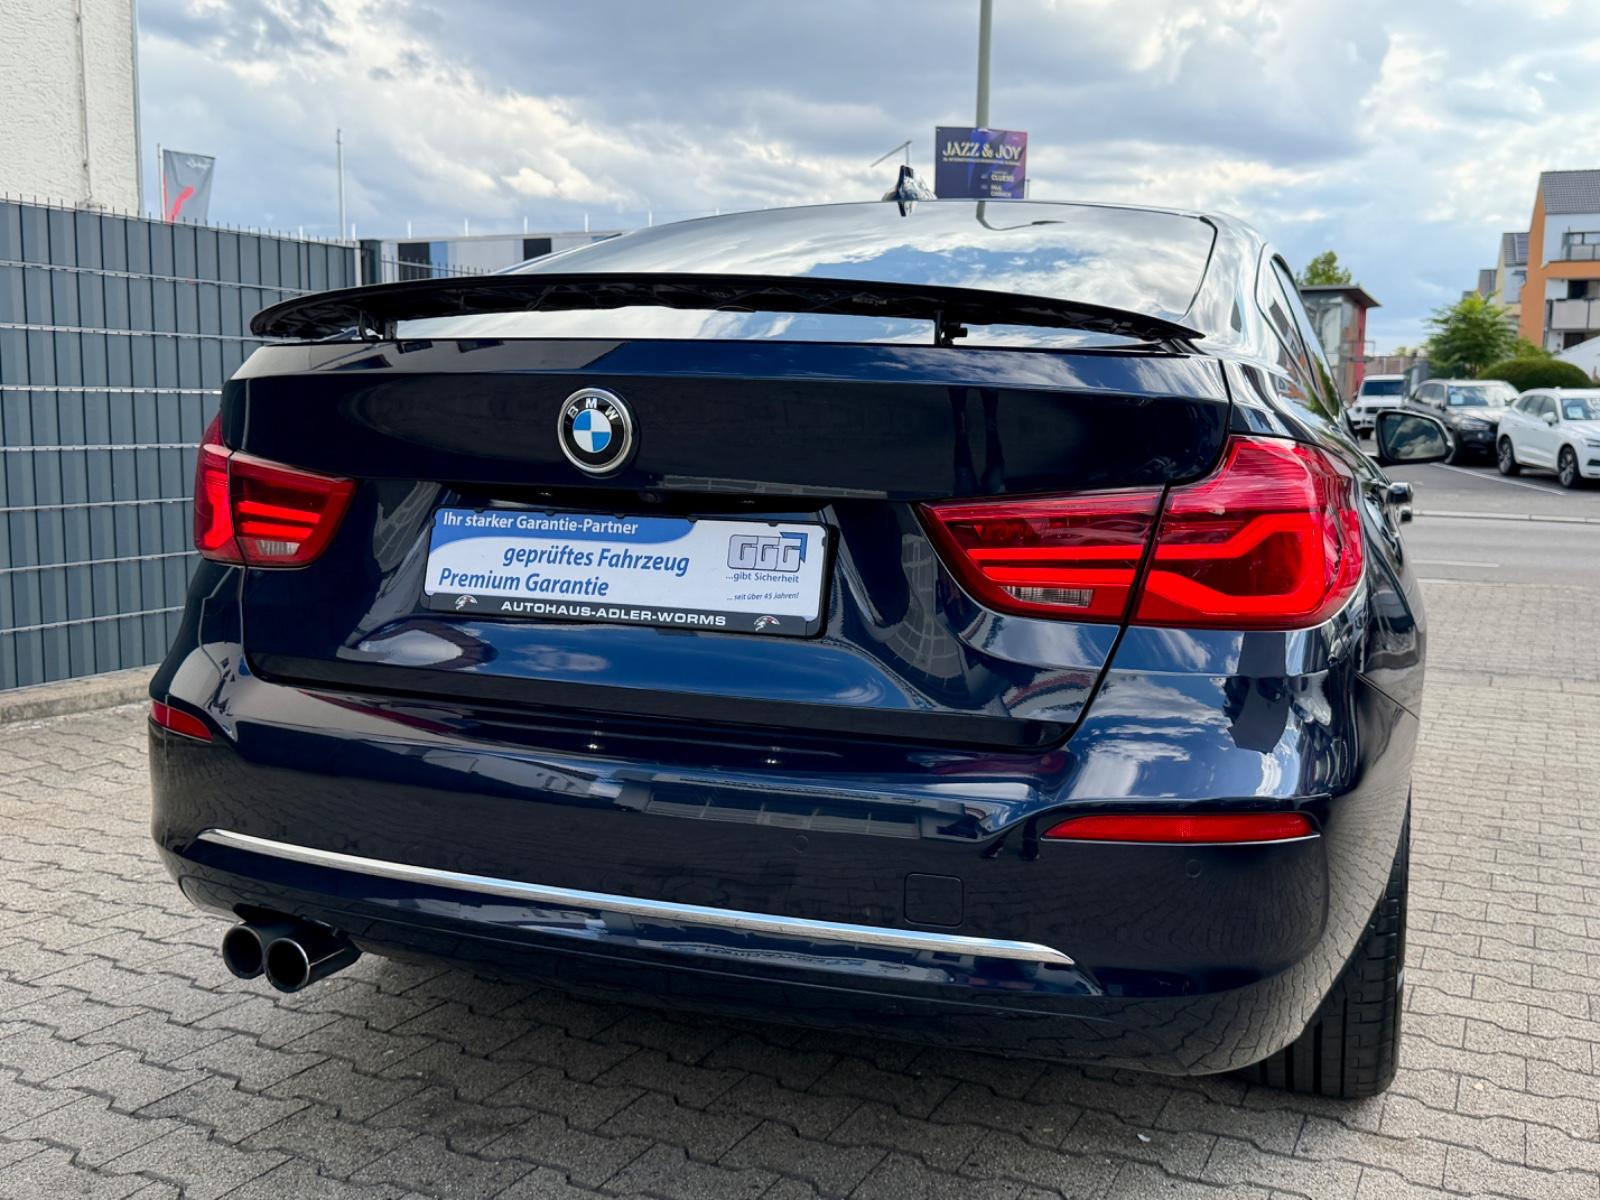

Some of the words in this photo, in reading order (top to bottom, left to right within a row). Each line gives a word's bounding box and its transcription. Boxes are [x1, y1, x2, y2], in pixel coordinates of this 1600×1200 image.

[942, 141, 980, 157] JAZZ
[981, 143, 993, 158] &
[995, 145, 1022, 160] JOY
[567, 397, 619, 420] BMW
[443, 511, 463, 526] Ihr
[465, 513, 514, 529] starker
[516, 515, 638, 535] Garantie-Partner
[502, 545, 594, 567] geprüftes
[597, 547, 690, 577] Fahrzeug
[438, 567, 521, 591] Premium
[525, 573, 609, 597] Garantie
[754, 572, 800, 583] Sicherheit
[747, 592, 763, 600] über
[501, 601, 727, 626] AUTOHAUS-ADLER-WORMS
